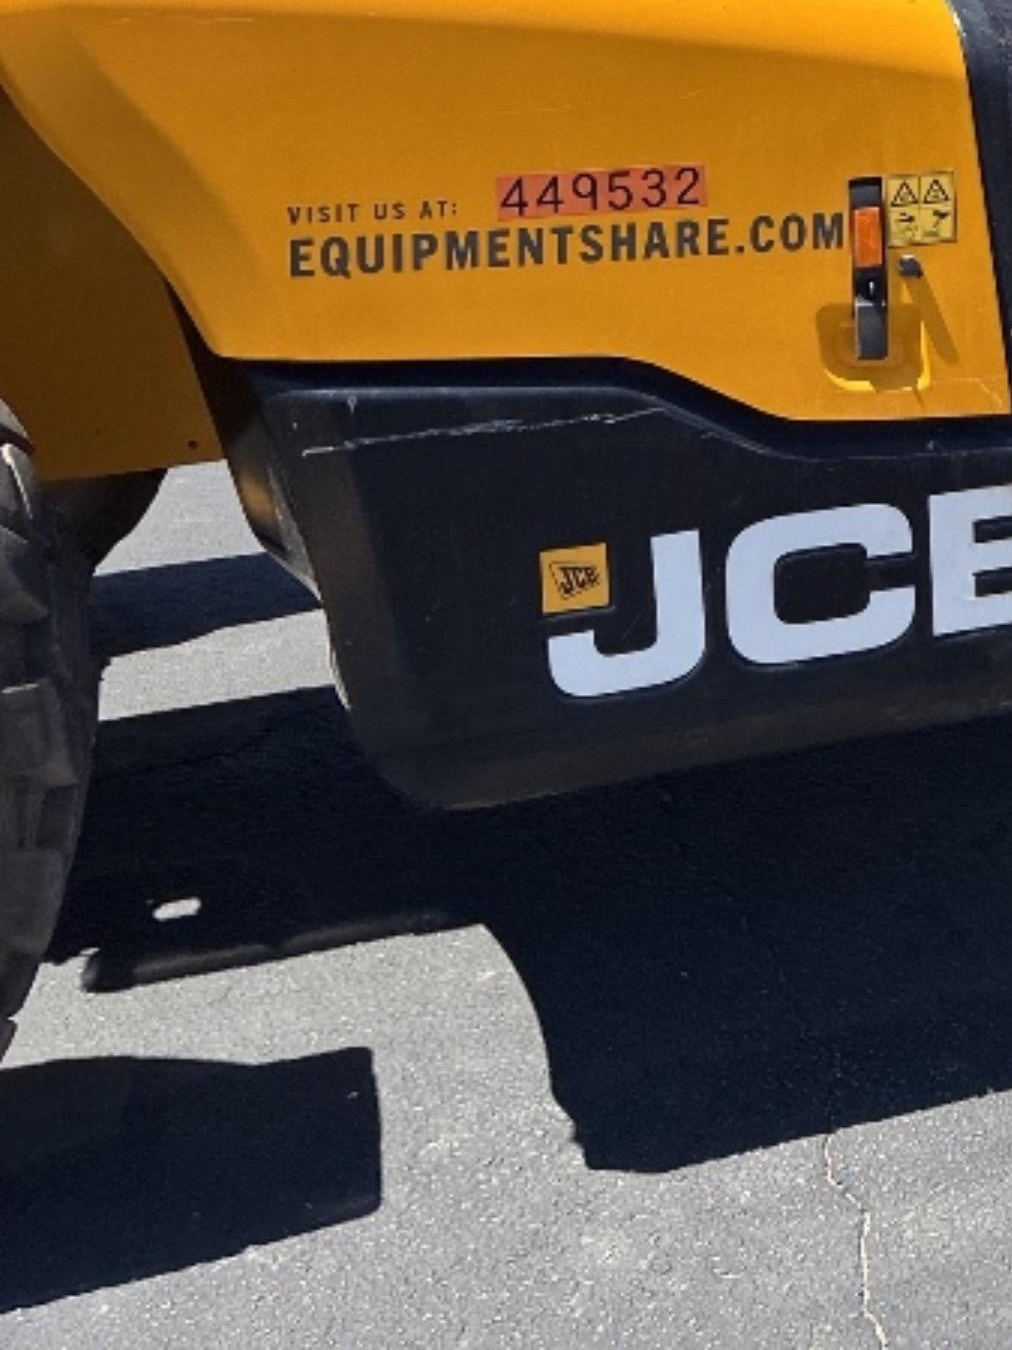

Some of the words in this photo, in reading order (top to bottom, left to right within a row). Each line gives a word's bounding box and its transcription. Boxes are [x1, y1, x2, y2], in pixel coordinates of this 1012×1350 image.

[500, 166, 700, 217] 449532
[287, 203, 360, 225] VISIT
[373, 202, 406, 220] US
[418, 200, 458, 220] AT:
[289, 212, 844, 279] EQUIPMENTSHARE.COM
[559, 565, 599, 595] JCB
